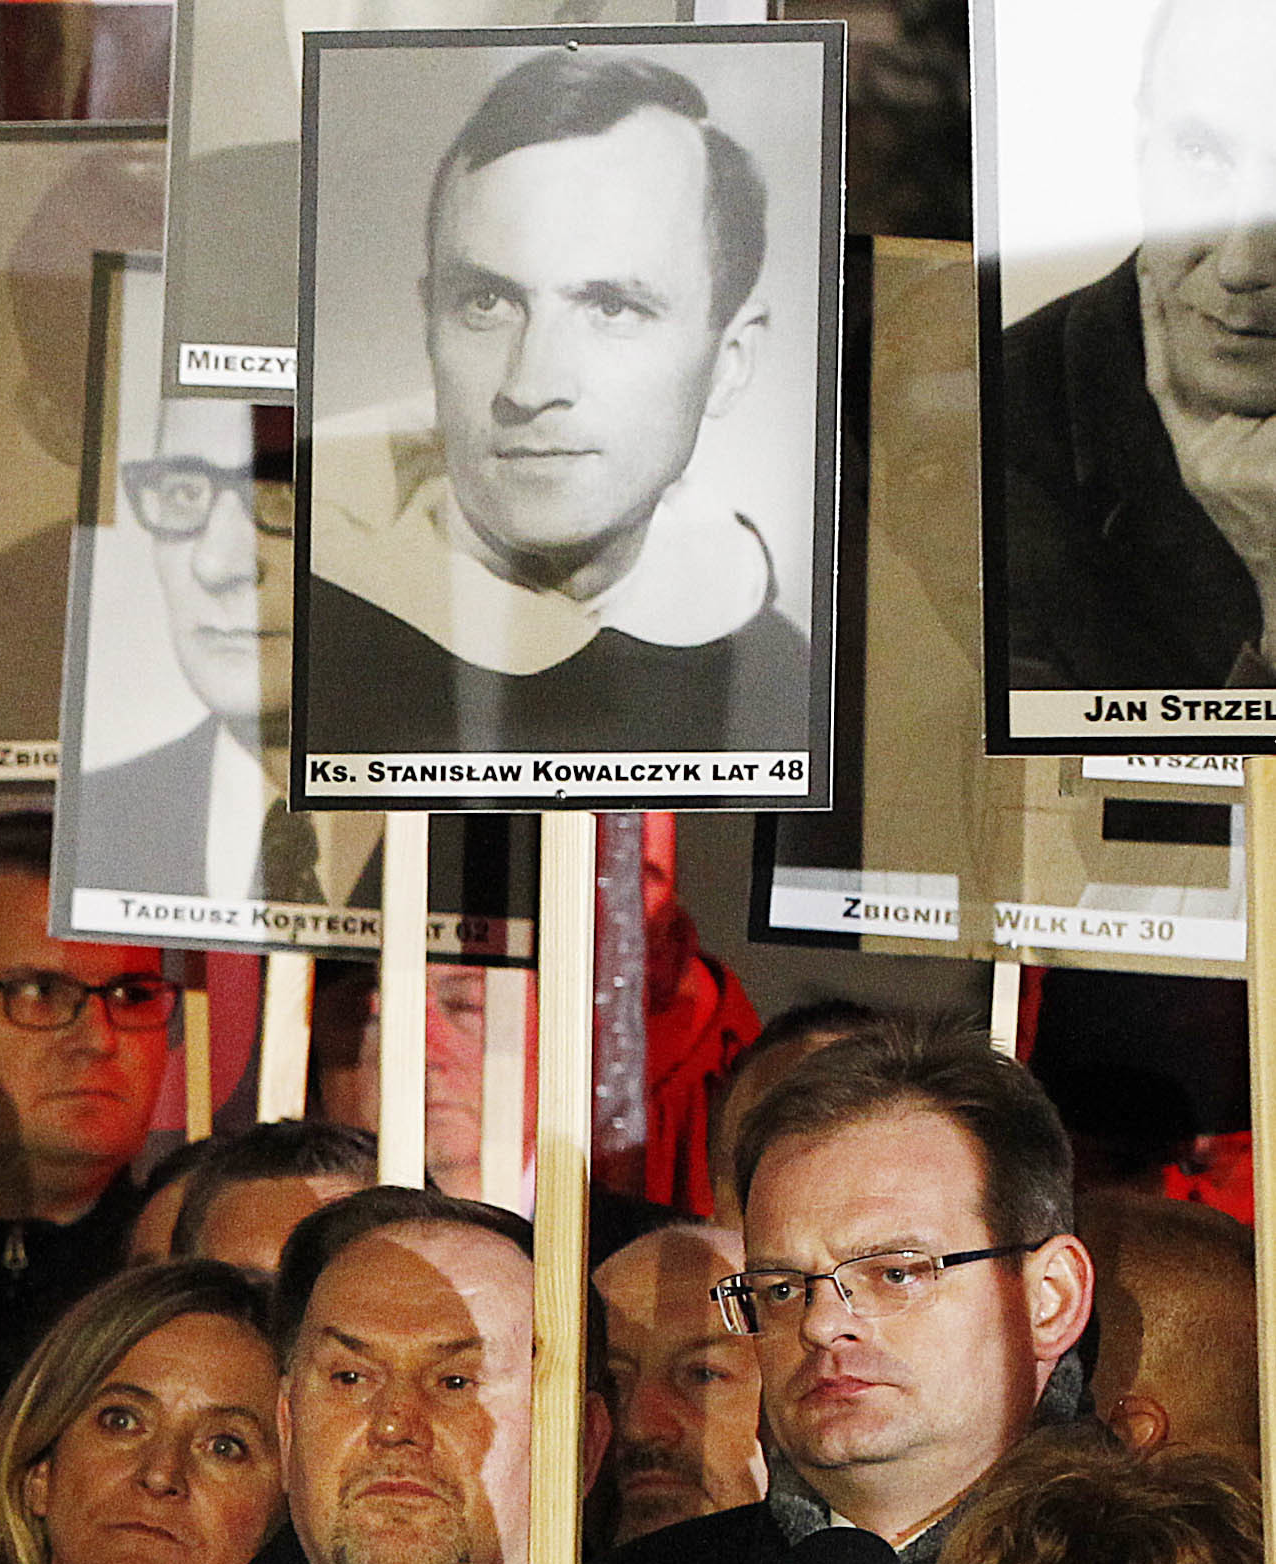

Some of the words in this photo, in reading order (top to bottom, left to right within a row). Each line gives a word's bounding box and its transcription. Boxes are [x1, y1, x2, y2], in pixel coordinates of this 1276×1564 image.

[187, 350, 297, 373] MIECZY
[1083, 695, 1148, 722] JAN
[1160, 694, 1276, 722] STRZEL
[367, 760, 523, 783] STANISŁAW
[531, 760, 702, 783] KOWALCZYK
[711, 763, 759, 783] LAT
[768, 759, 805, 782] 48
[119, 898, 241, 926] TADEUSZ
[995, 907, 1068, 934] WILK
[1080, 919, 1129, 940] LAT
[1139, 918, 1175, 943] 30
